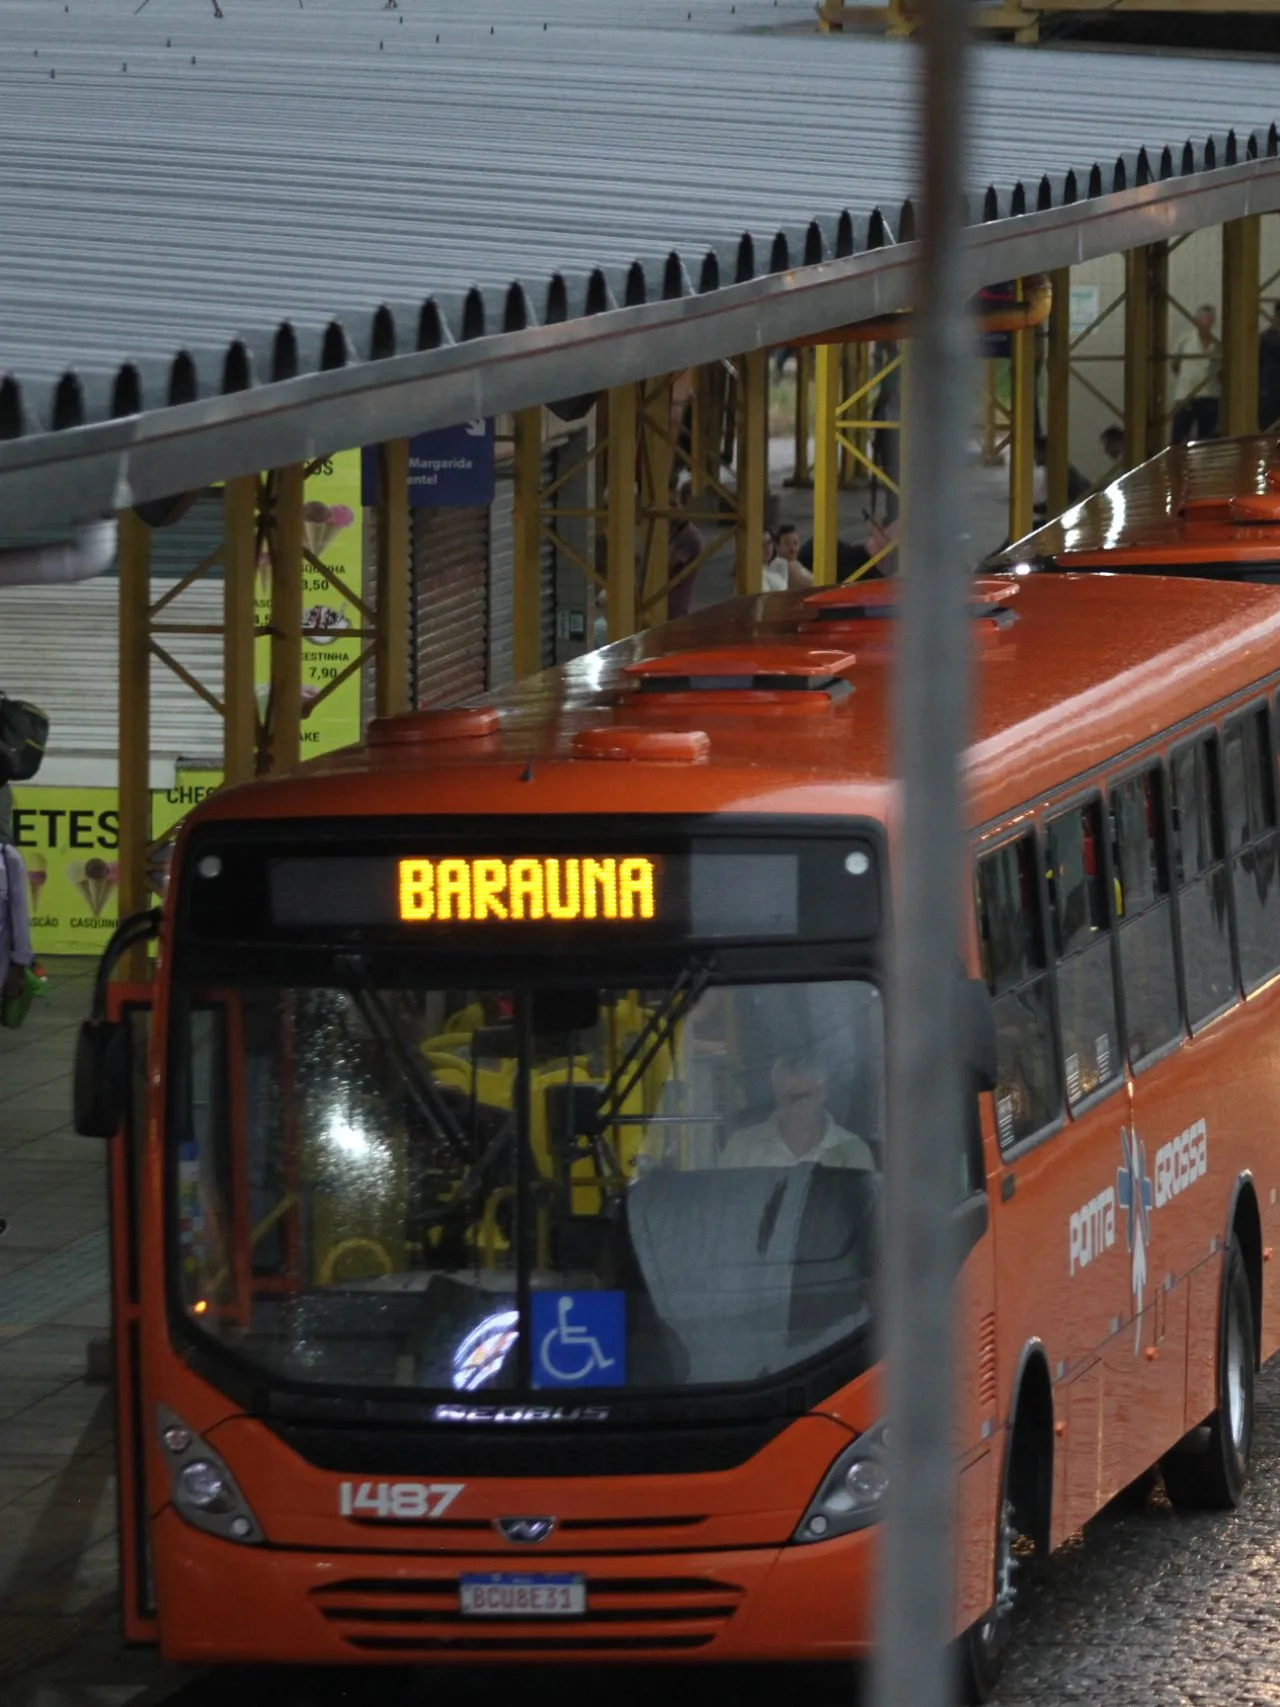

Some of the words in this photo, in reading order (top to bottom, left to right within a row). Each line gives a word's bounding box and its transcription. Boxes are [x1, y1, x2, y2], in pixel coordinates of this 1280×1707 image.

[408, 457, 473, 471] Margarida
[309, 667, 338, 679] 7,90
[398, 857, 656, 920] BARAUNA
[339, 1482, 466, 1517] 1487
